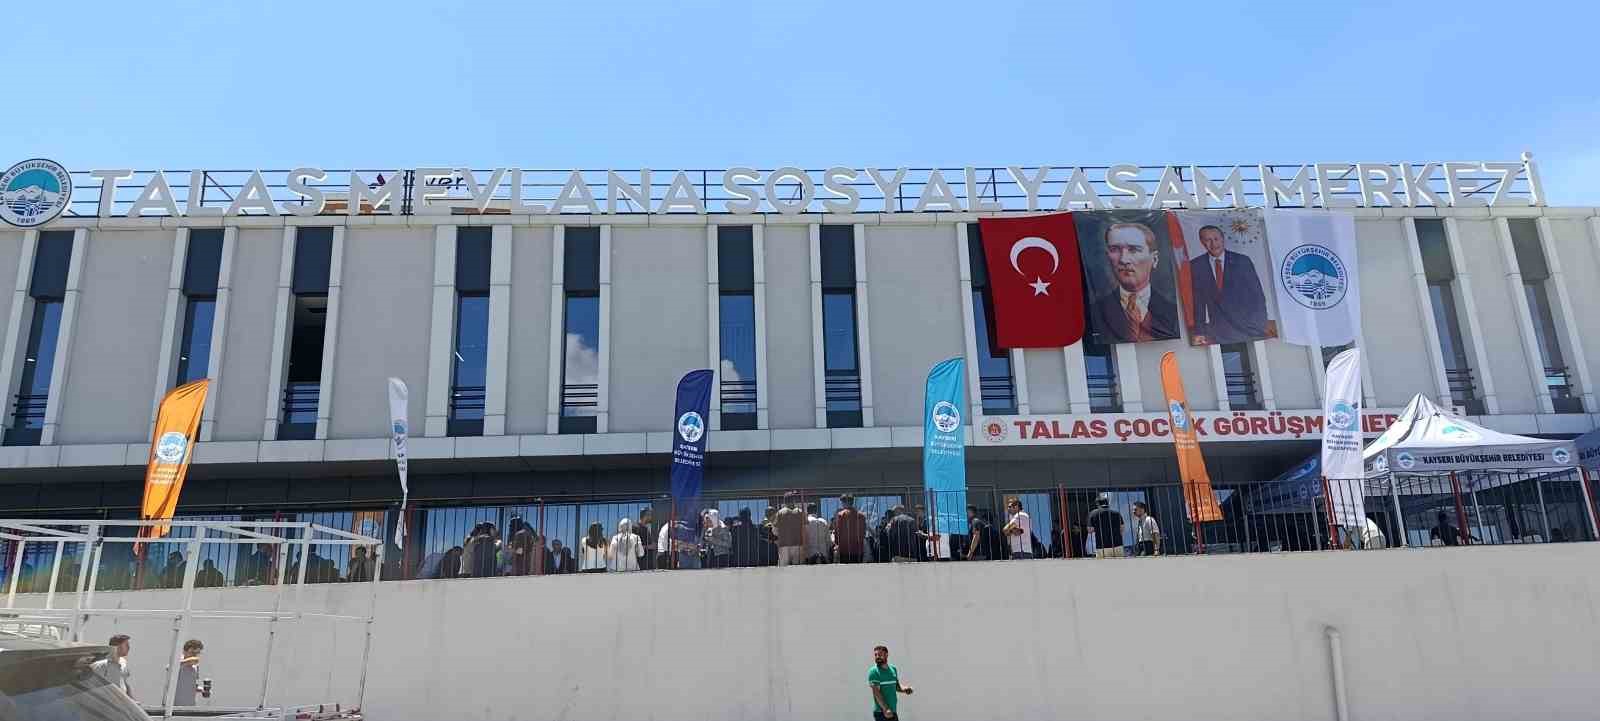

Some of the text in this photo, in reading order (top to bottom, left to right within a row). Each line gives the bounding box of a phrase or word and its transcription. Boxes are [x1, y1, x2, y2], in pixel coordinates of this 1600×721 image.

[90, 167, 328, 217] TALAS
[350, 167, 706, 216] MEVLANA
[722, 166, 1004, 214] SOSYAL
[1258, 151, 1548, 208] MERKEZİ
[1014, 420, 1108, 439] TALAS
[1114, 418, 1208, 441] ÇOCK
[1214, 411, 1324, 438] GÖRÜŞM
